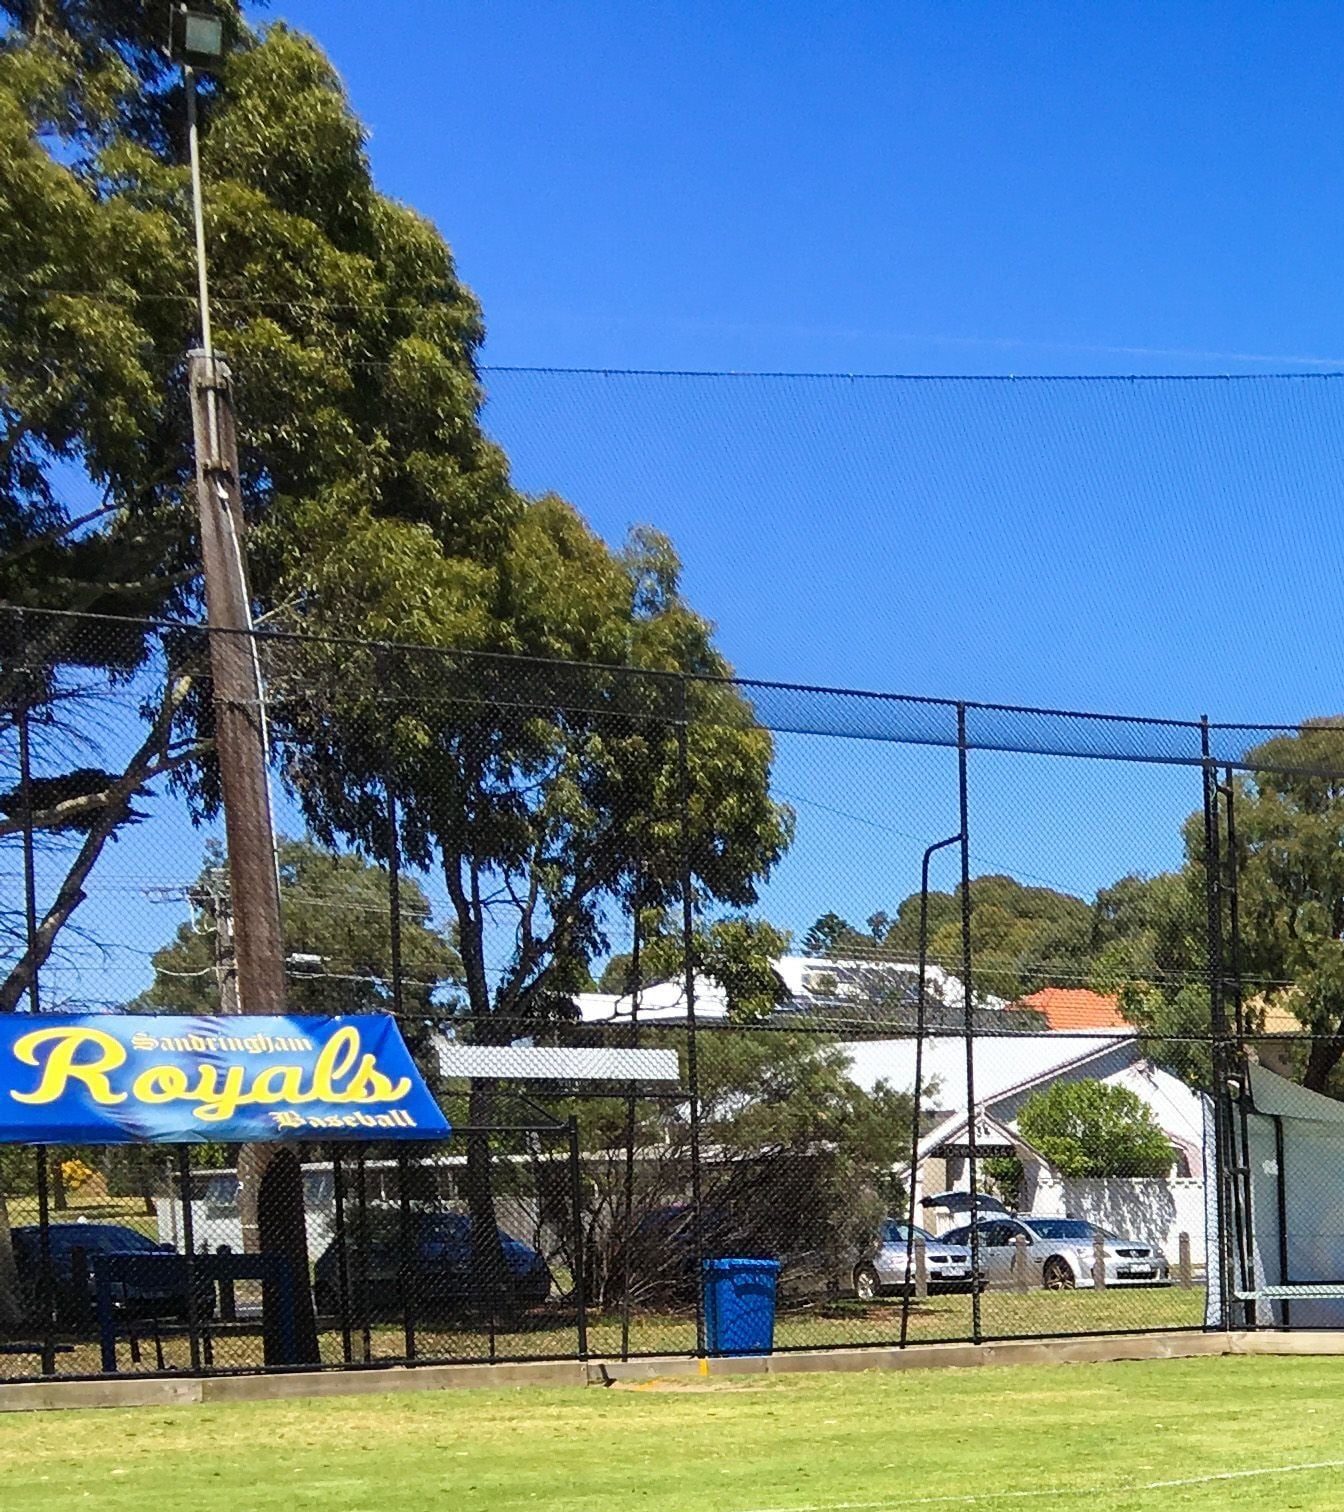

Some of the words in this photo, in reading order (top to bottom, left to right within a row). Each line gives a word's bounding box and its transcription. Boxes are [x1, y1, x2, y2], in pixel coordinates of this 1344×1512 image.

[131, 1032, 313, 1053] Sandringham
[9, 1026, 413, 1122] Royals
[268, 1109, 417, 1131] Baseball
